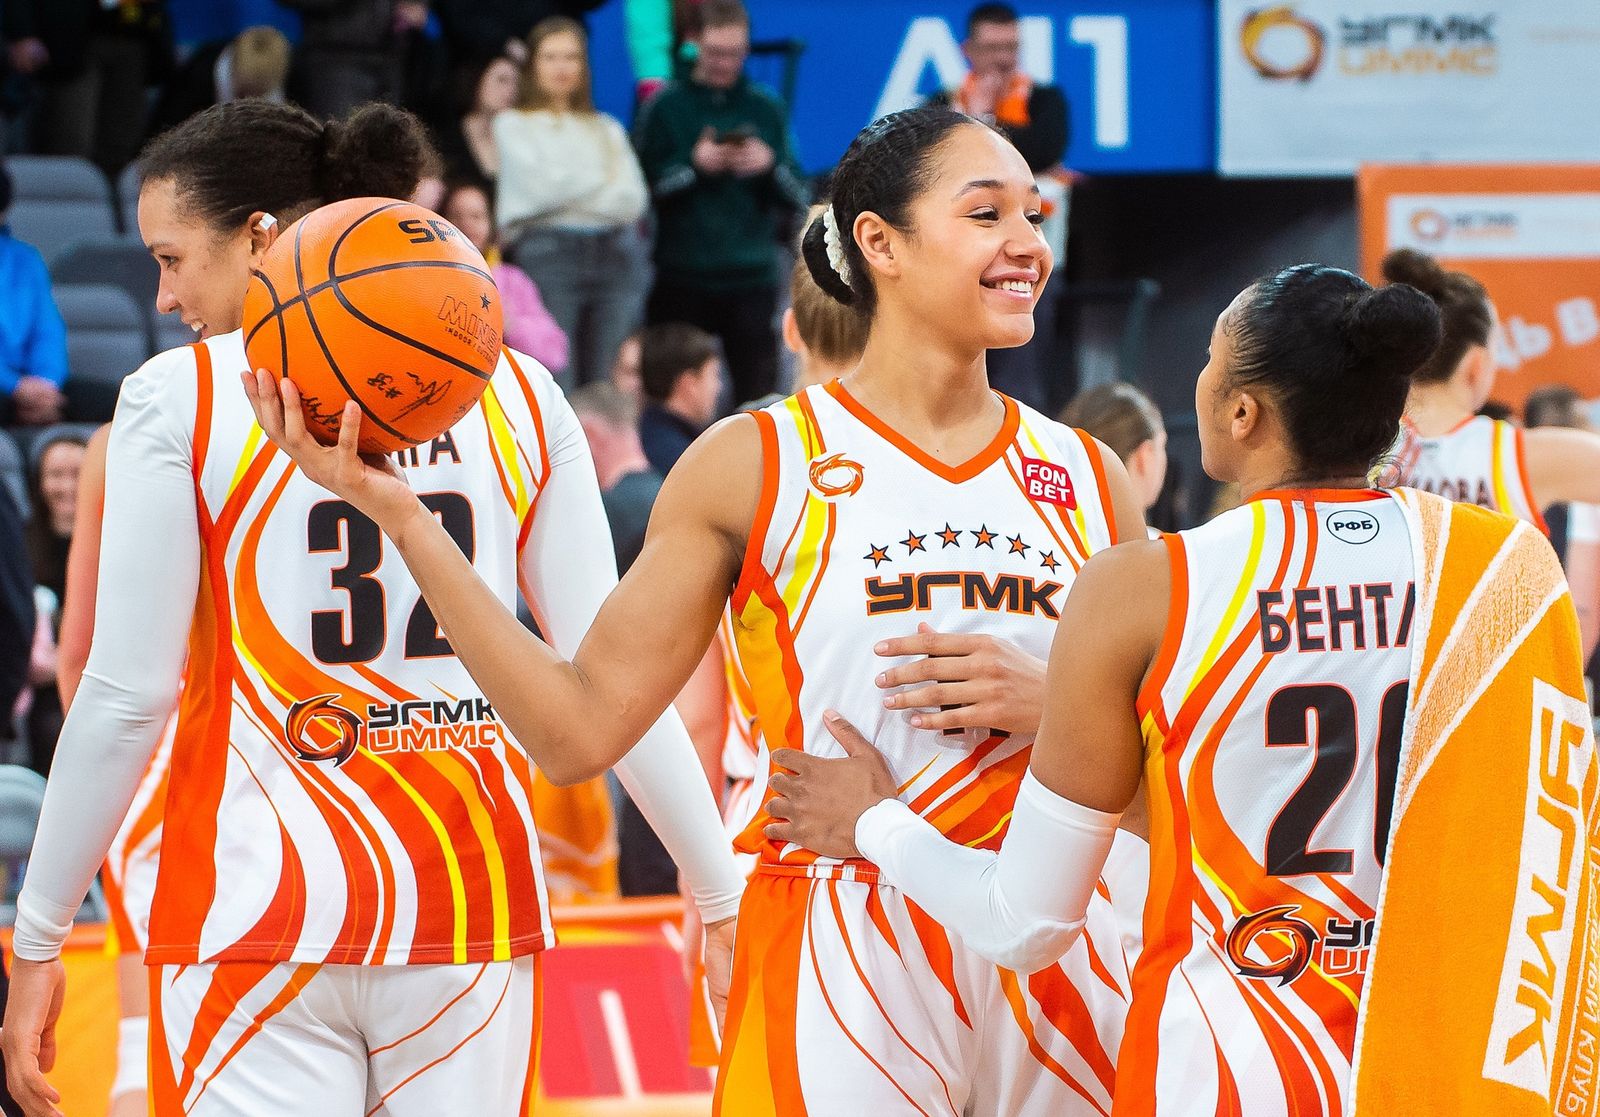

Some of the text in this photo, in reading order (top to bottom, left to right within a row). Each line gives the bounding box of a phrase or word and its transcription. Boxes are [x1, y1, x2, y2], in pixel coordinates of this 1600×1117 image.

[1026, 463, 1066, 487] FON
[1029, 479, 1070, 502] BET
[1333, 519, 1373, 531] РФБ
[308, 490, 476, 666] 32
[865, 571, 1064, 621] УГМК
[368, 697, 496, 729] УГМК
[369, 723, 496, 754] UMMC
[1503, 706, 1585, 1074] УГМК
[1565, 1028, 1597, 1116] КЛУБ
